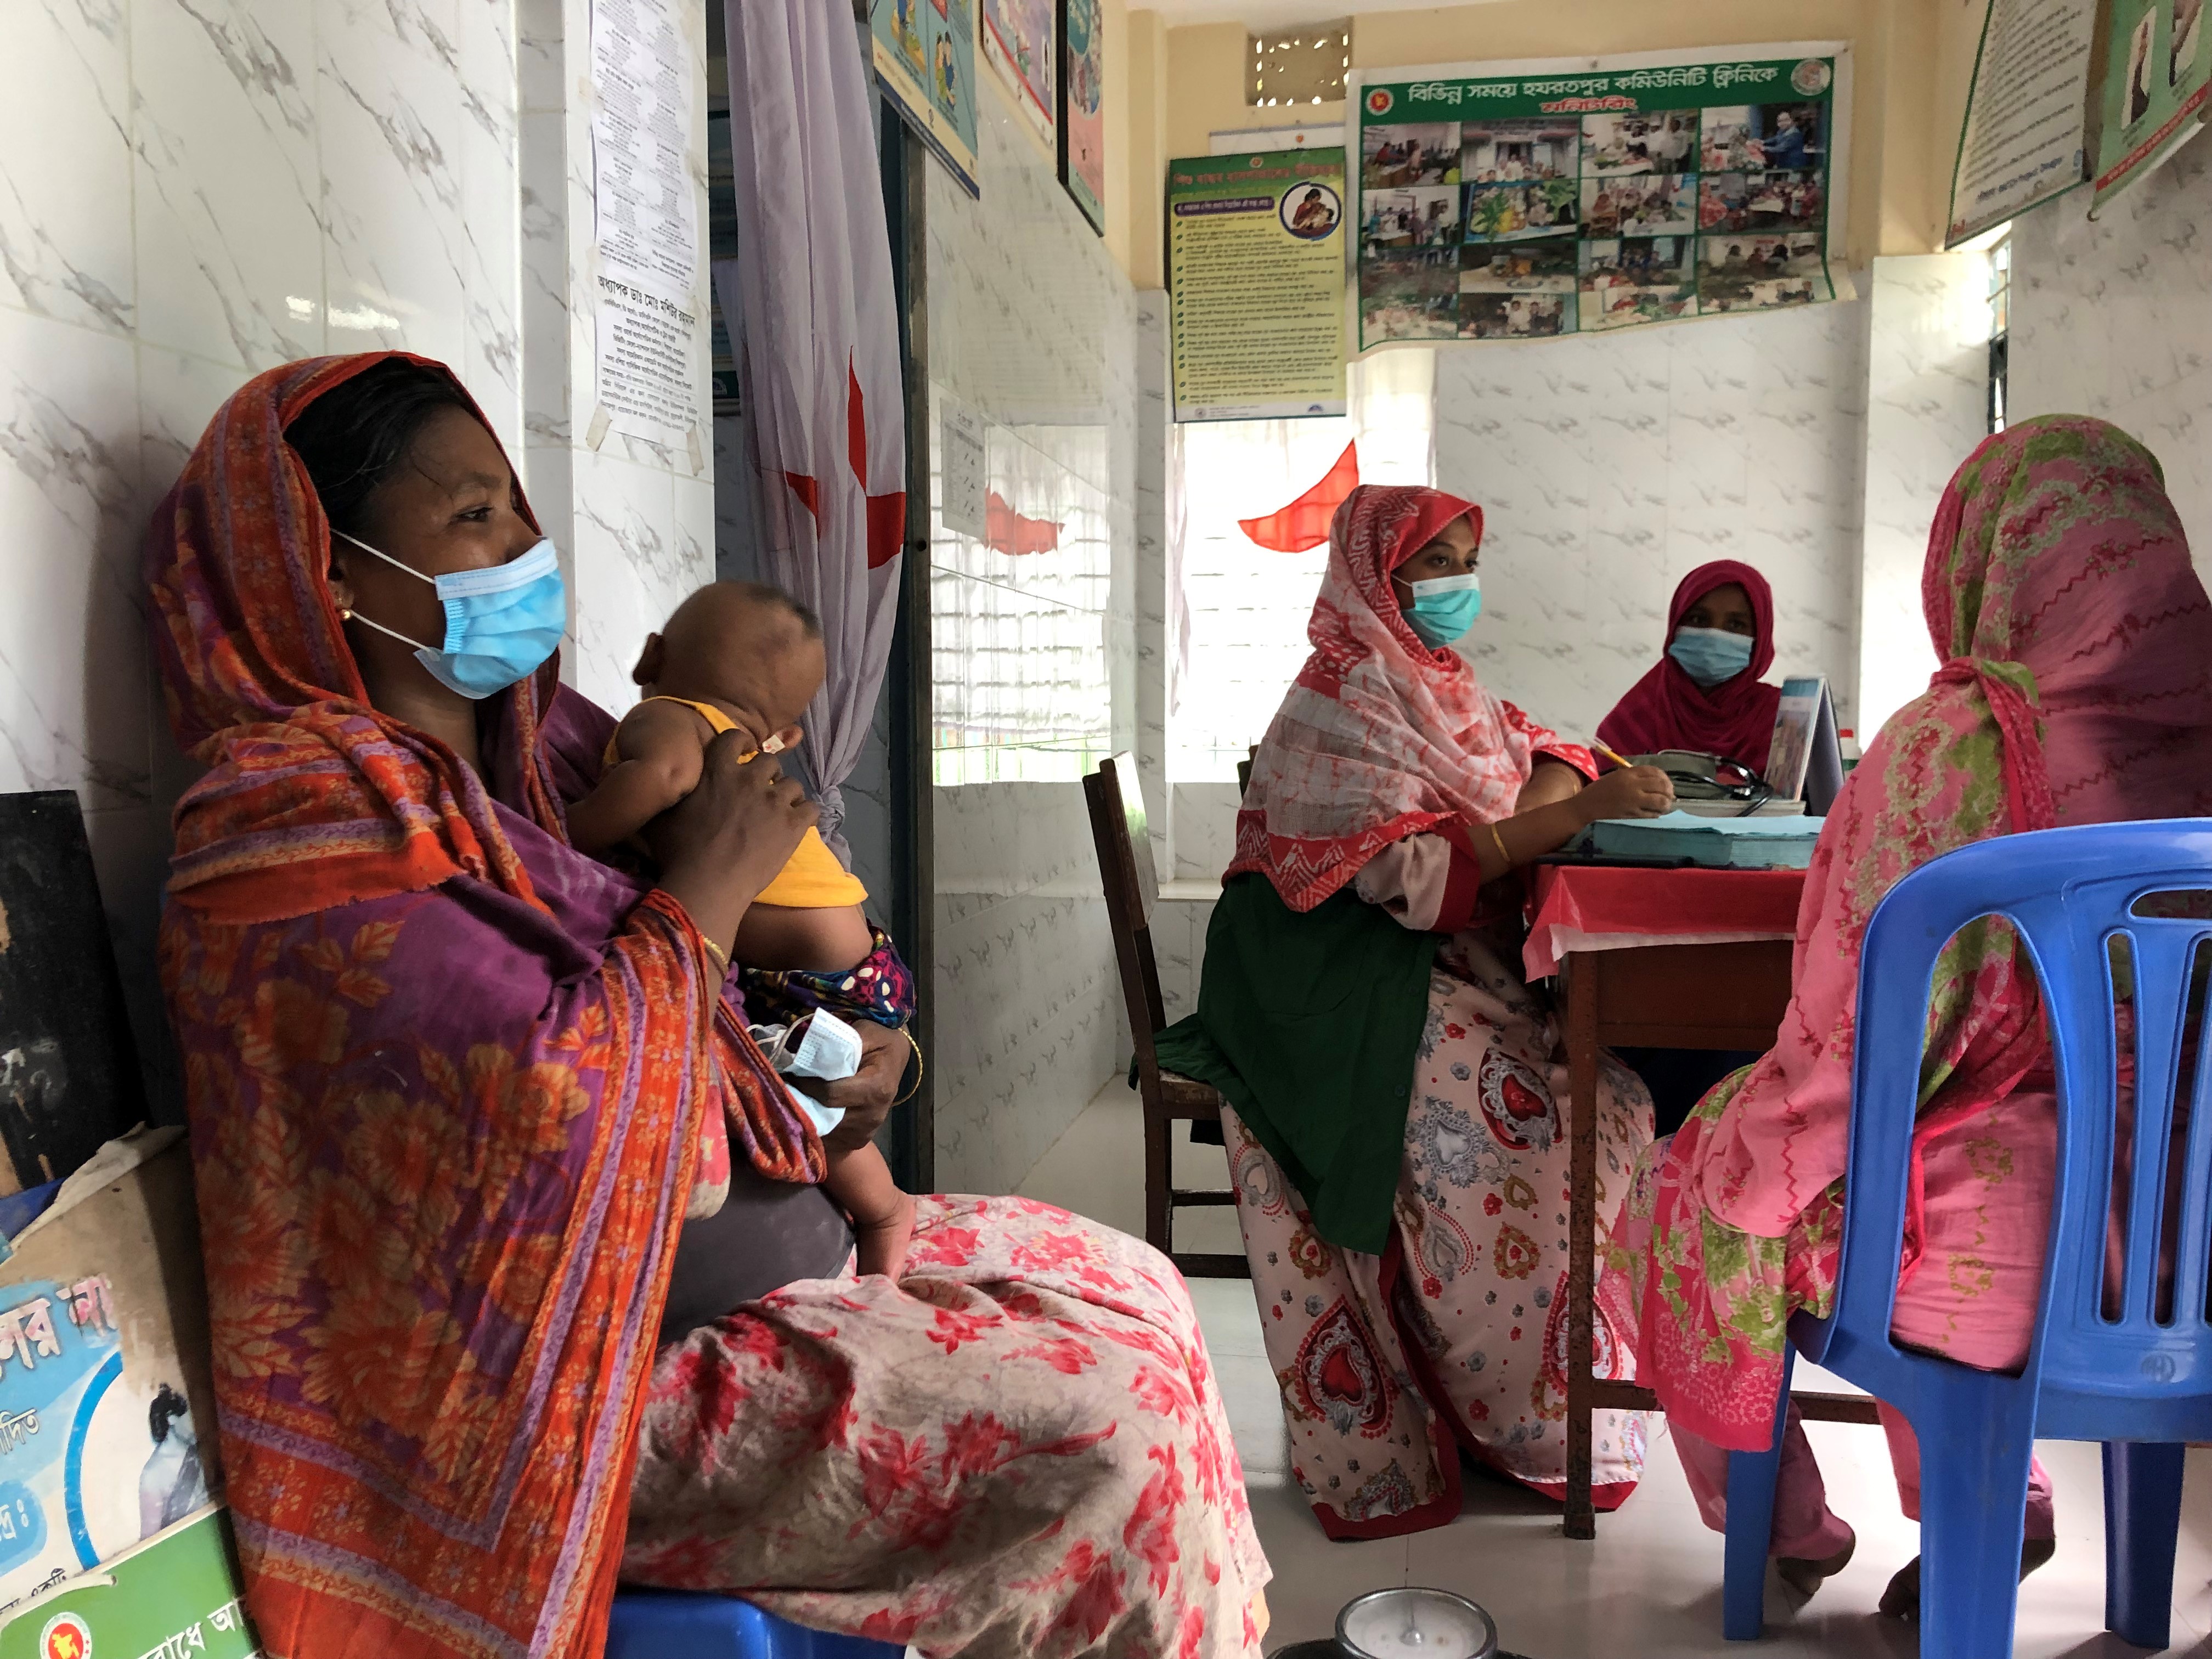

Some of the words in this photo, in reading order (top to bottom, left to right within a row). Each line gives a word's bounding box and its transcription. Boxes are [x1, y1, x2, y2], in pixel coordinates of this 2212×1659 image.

[1408, 82, 1463, 105] বিভিন্ন
[1466, 82, 1518, 98] সময়ে
[1522, 76, 1609, 98] হযরতপুর
[1613, 66, 1708, 91] কমিউনিটি
[1712, 64, 1779, 89] ক্লিনিকে
[597, 274, 629, 297] অধ্যাপক
[630, 287, 643, 304] ডাঃ
[644, 293, 659, 311] মোঃ
